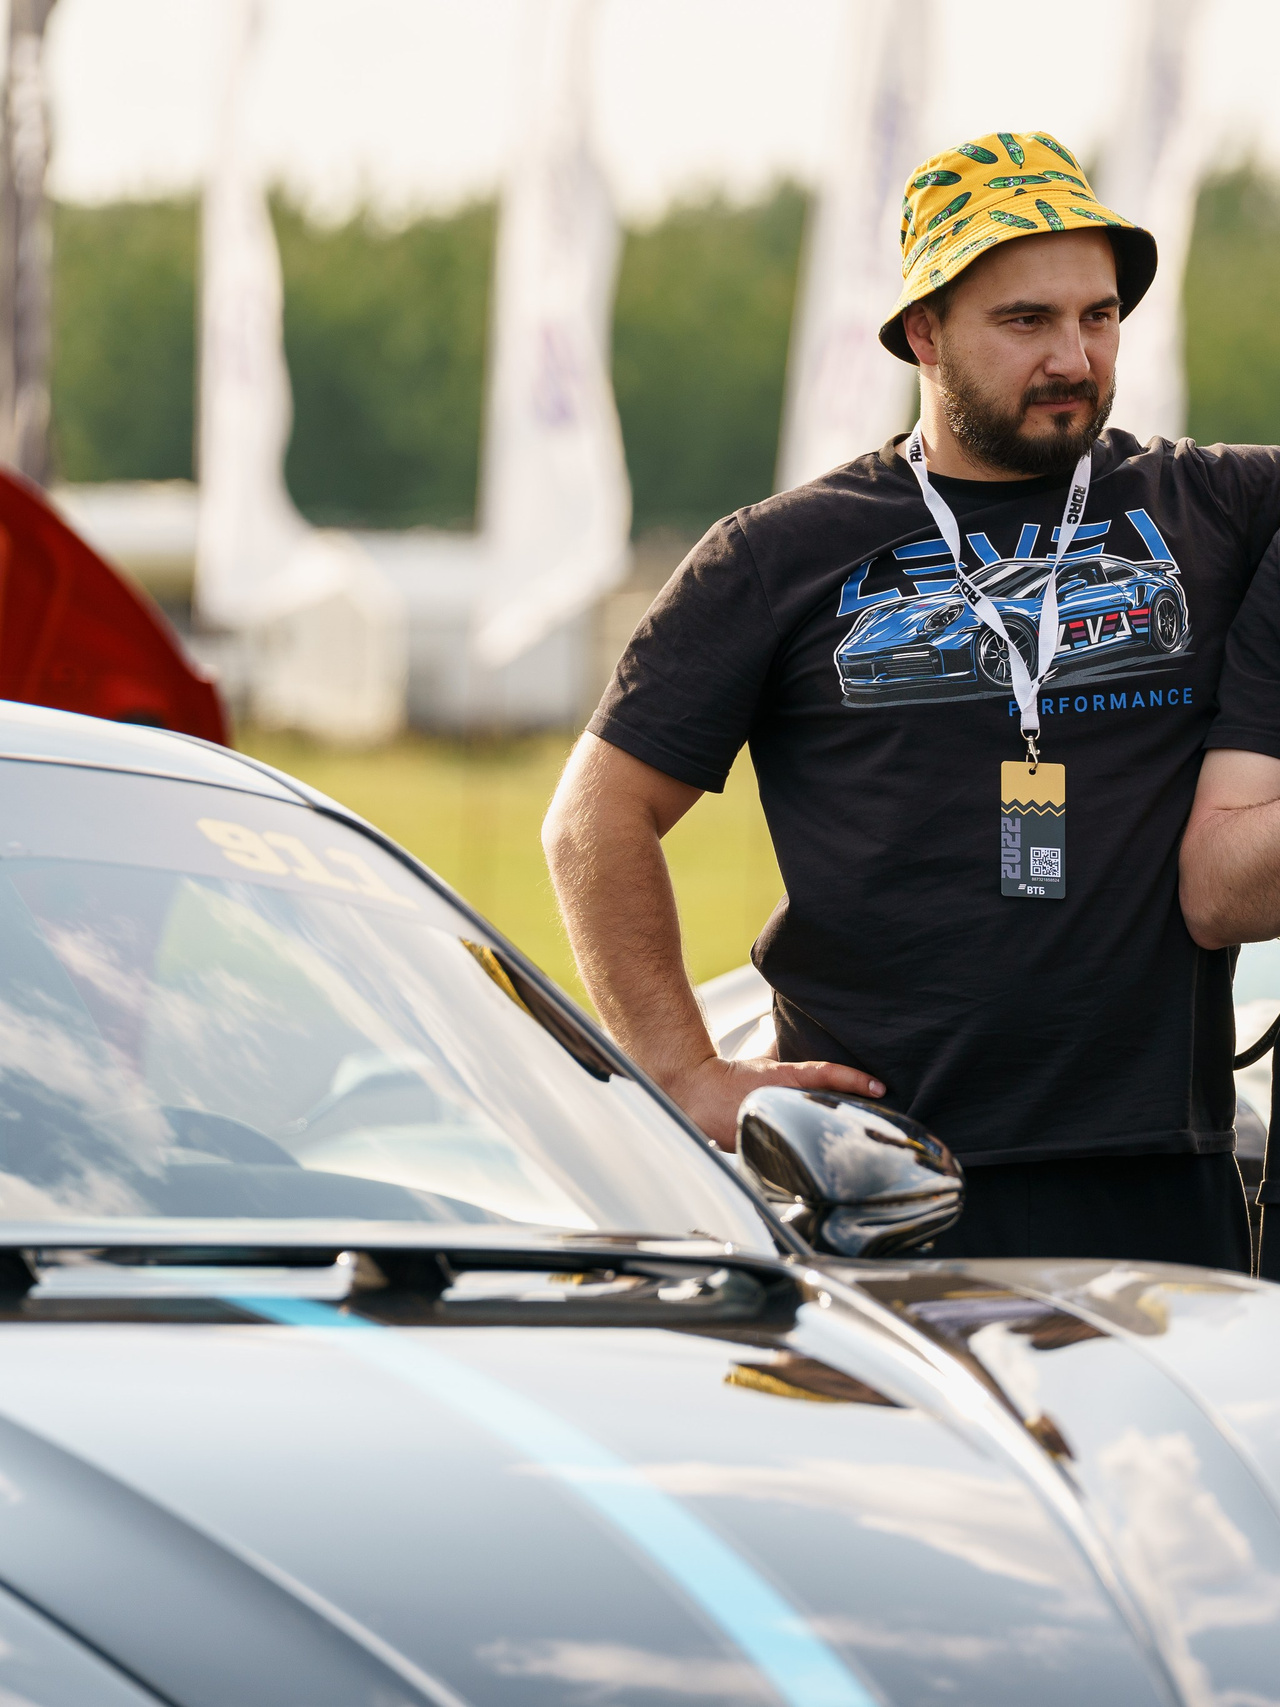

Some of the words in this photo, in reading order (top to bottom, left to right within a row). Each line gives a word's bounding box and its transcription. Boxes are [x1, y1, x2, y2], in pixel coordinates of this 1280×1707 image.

[1066, 484, 1087, 525] RDRC
[1008, 687, 1193, 717] PRFORMANCE
[196, 817, 420, 911] 911
[1026, 886, 1046, 895] ВТБ
